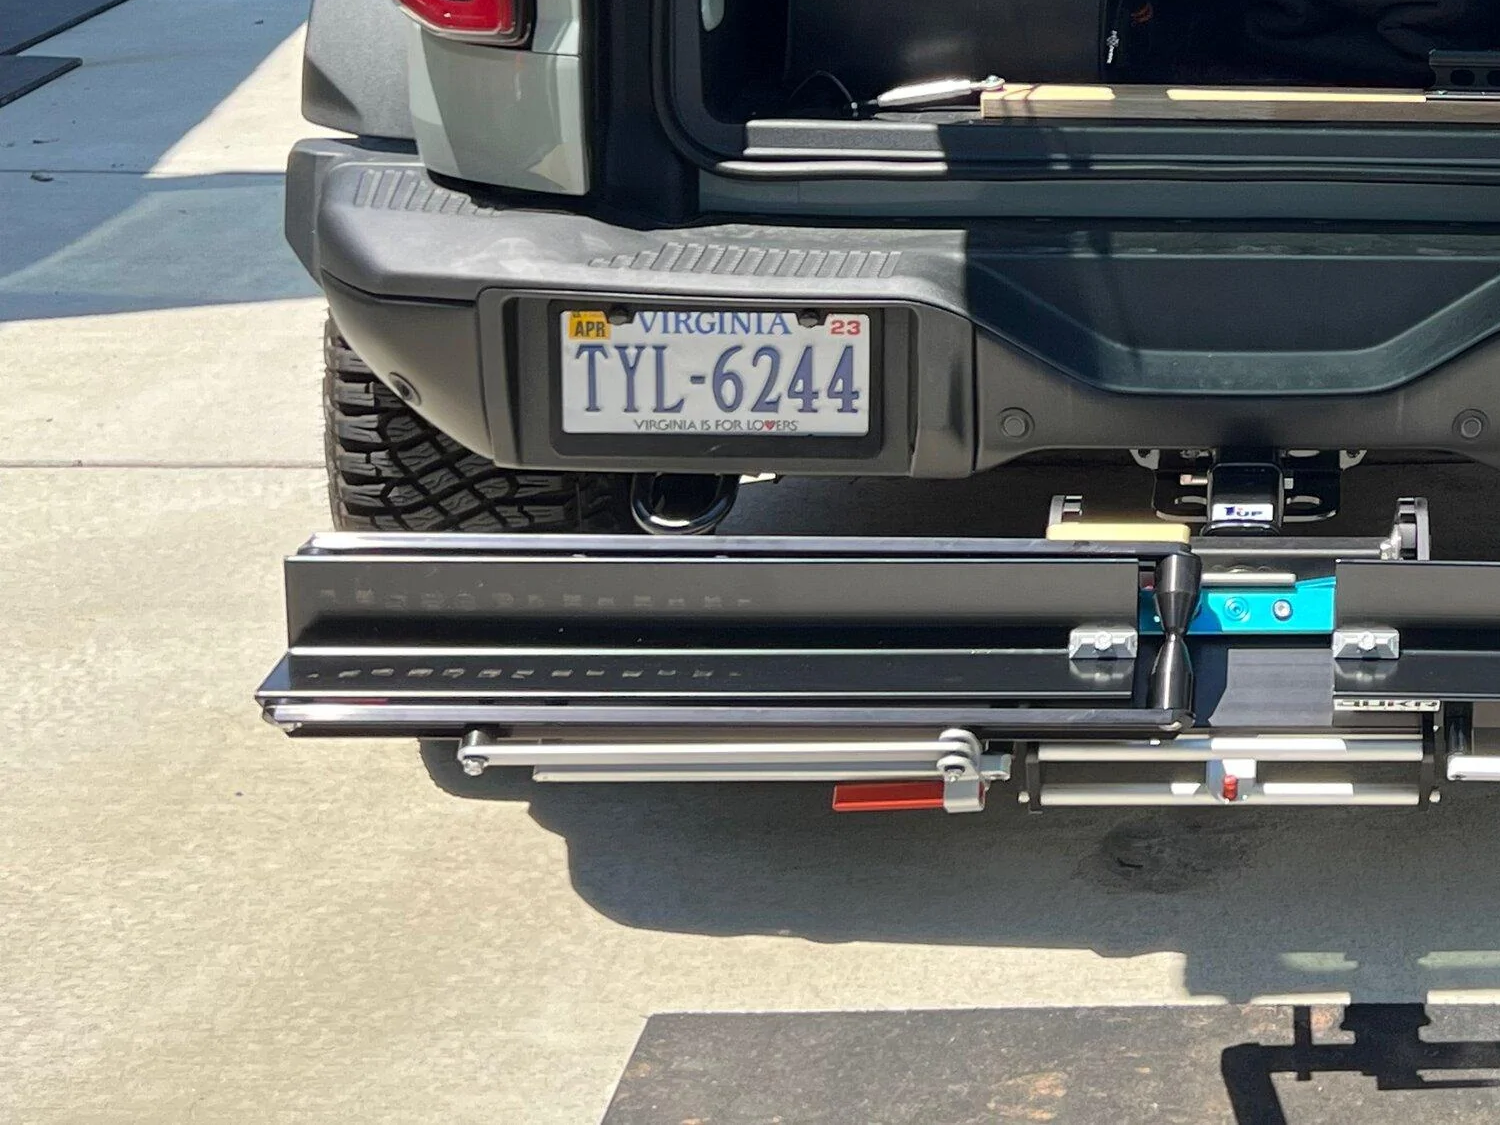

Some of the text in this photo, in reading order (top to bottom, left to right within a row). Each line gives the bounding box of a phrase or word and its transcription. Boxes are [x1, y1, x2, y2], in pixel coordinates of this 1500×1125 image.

[574, 321, 607, 338] APR
[637, 311, 792, 335] VIRGINIA
[830, 320, 861, 335] 23
[575, 345, 860, 413] TYL-6244
[633, 419, 697, 431] VIRGINIA
[700, 419, 711, 431] IS
[715, 419, 742, 431] FOR
